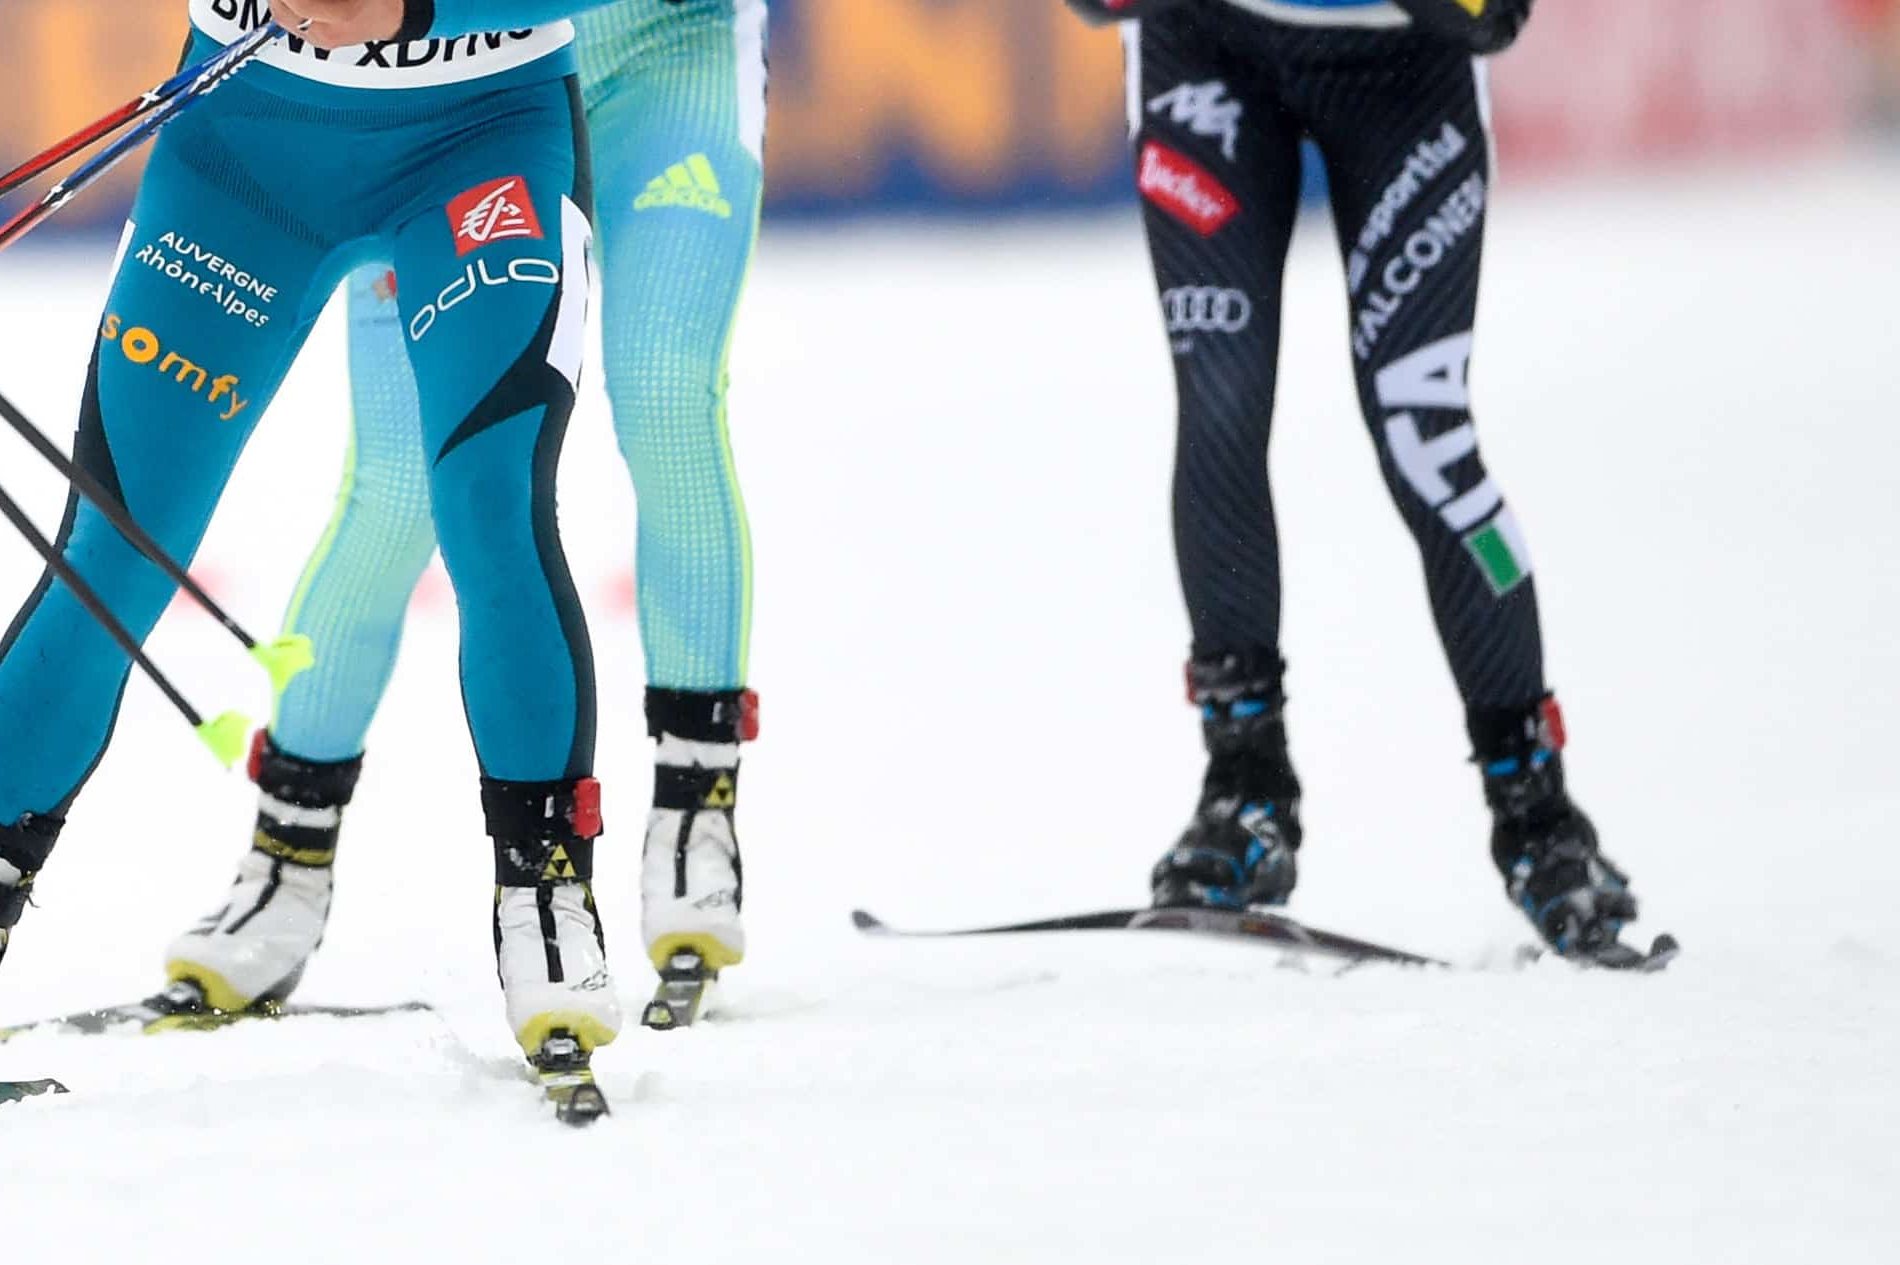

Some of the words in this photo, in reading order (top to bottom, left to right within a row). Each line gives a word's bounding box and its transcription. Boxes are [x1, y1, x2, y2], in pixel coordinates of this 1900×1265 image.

[158, 231, 278, 303] AUVERGNE
[410, 258, 559, 341] odlo
[101, 313, 249, 421] somfy
